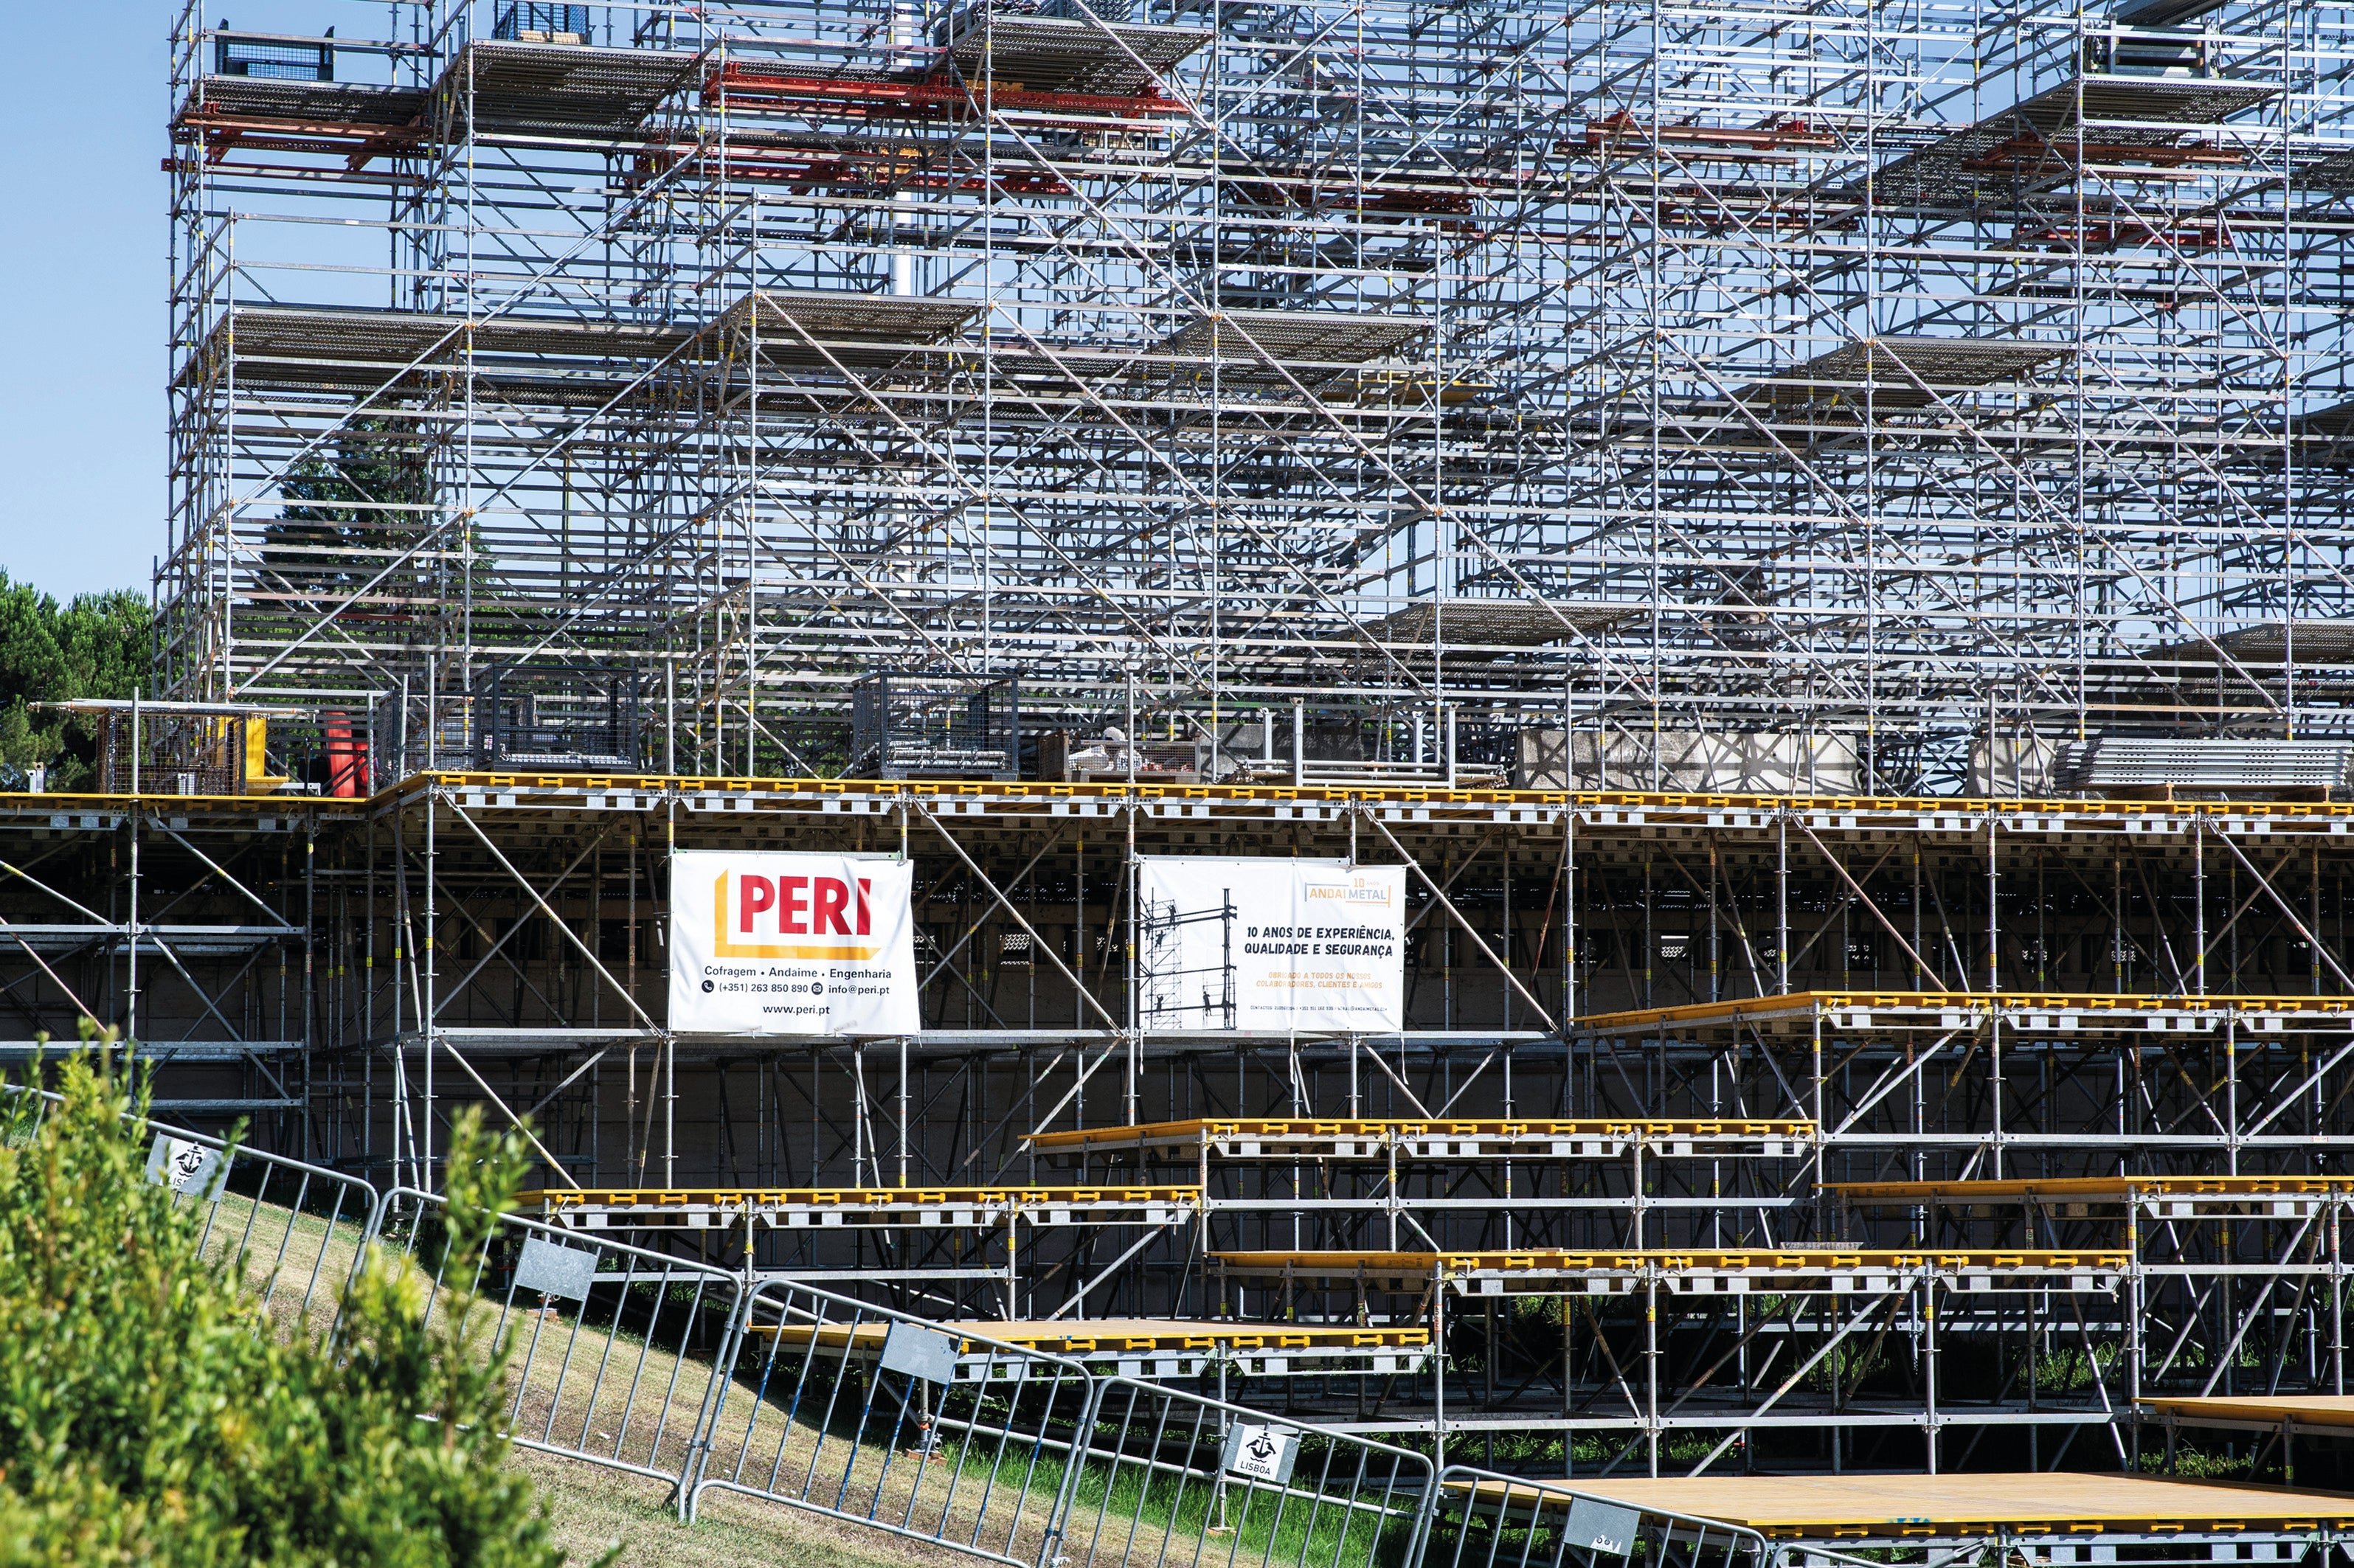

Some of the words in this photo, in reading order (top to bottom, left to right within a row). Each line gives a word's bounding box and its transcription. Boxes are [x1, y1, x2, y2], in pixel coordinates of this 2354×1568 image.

[1354, 878, 1365, 888] 10
[740, 874, 872, 936] PERI
[1247, 926, 1258, 937] 10
[1262, 926, 1293, 938] ANOS
[1297, 927, 1312, 939] DE
[1316, 924, 1395, 941] EXPERIÊNCIA,
[1244, 943, 1309, 955] QUALIDADE
[1312, 943, 1321, 955] E
[1325, 943, 1393, 960] SEGURANÇA
[704, 965, 757, 978] Cofragem
[769, 967, 818, 978] Andaime
[829, 968, 892, 980] Engenharia
[1346, 972, 1371, 980] NOSSOS
[719, 983, 748, 993] (+351)
[750, 983, 769, 993] 263
[771, 984, 789, 993] 850
[791, 985, 809, 993] 890
[828, 985, 890, 996] info@peri.pt
[1317, 980, 1351, 989] CLIENTES
[1351, 981, 1357, 989] E
[1359, 981, 1383, 990] AMIGOS
[763, 1005, 831, 1016] www.peri.pt
[1239, 1460, 1271, 1476] LISBOA
